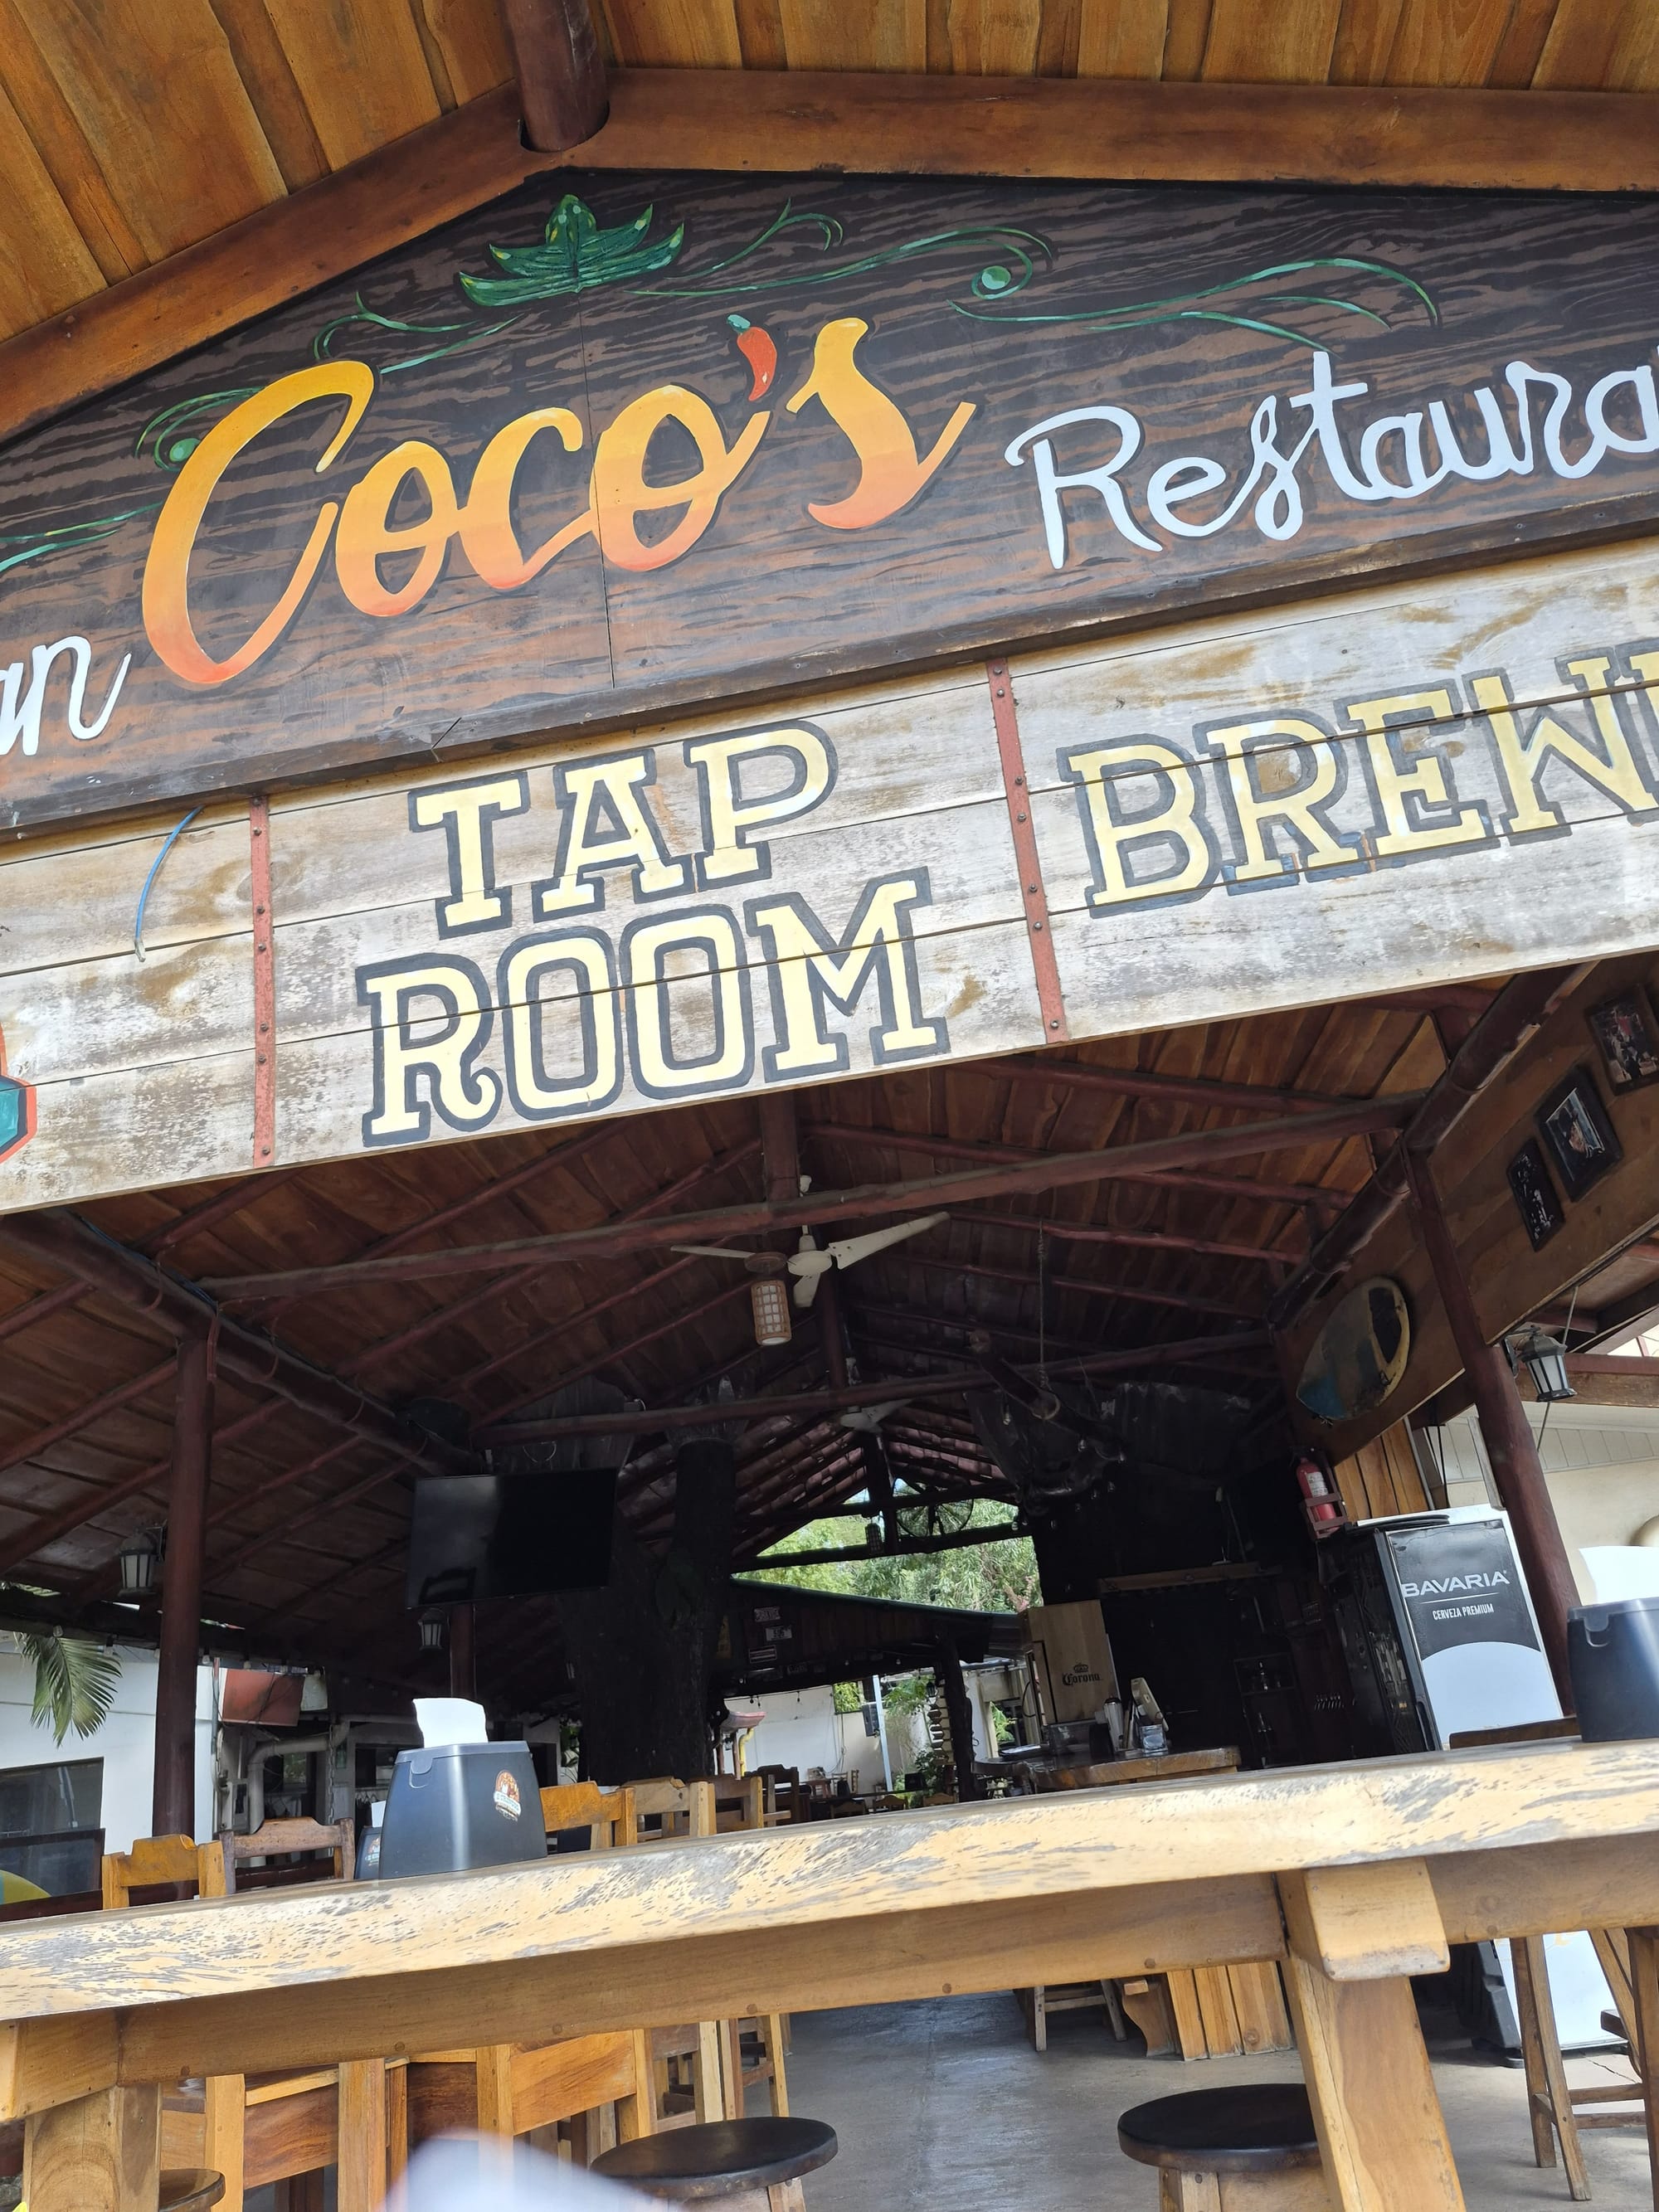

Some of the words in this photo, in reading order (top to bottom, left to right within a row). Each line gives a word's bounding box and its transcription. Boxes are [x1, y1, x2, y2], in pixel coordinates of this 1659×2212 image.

[140, 315, 976, 683] Coco's
[1005, 342, 1659, 569] Restaura
[408, 720, 838, 939] TAP
[355, 866, 951, 1146] ROOM
[1402, 1571, 1510, 1597] BAVARIA
[1433, 1608, 1462, 1621] CERVEZA
[1462, 1603, 1494, 1616] PREMIUM
[1063, 1673, 1101, 1686] Corona
